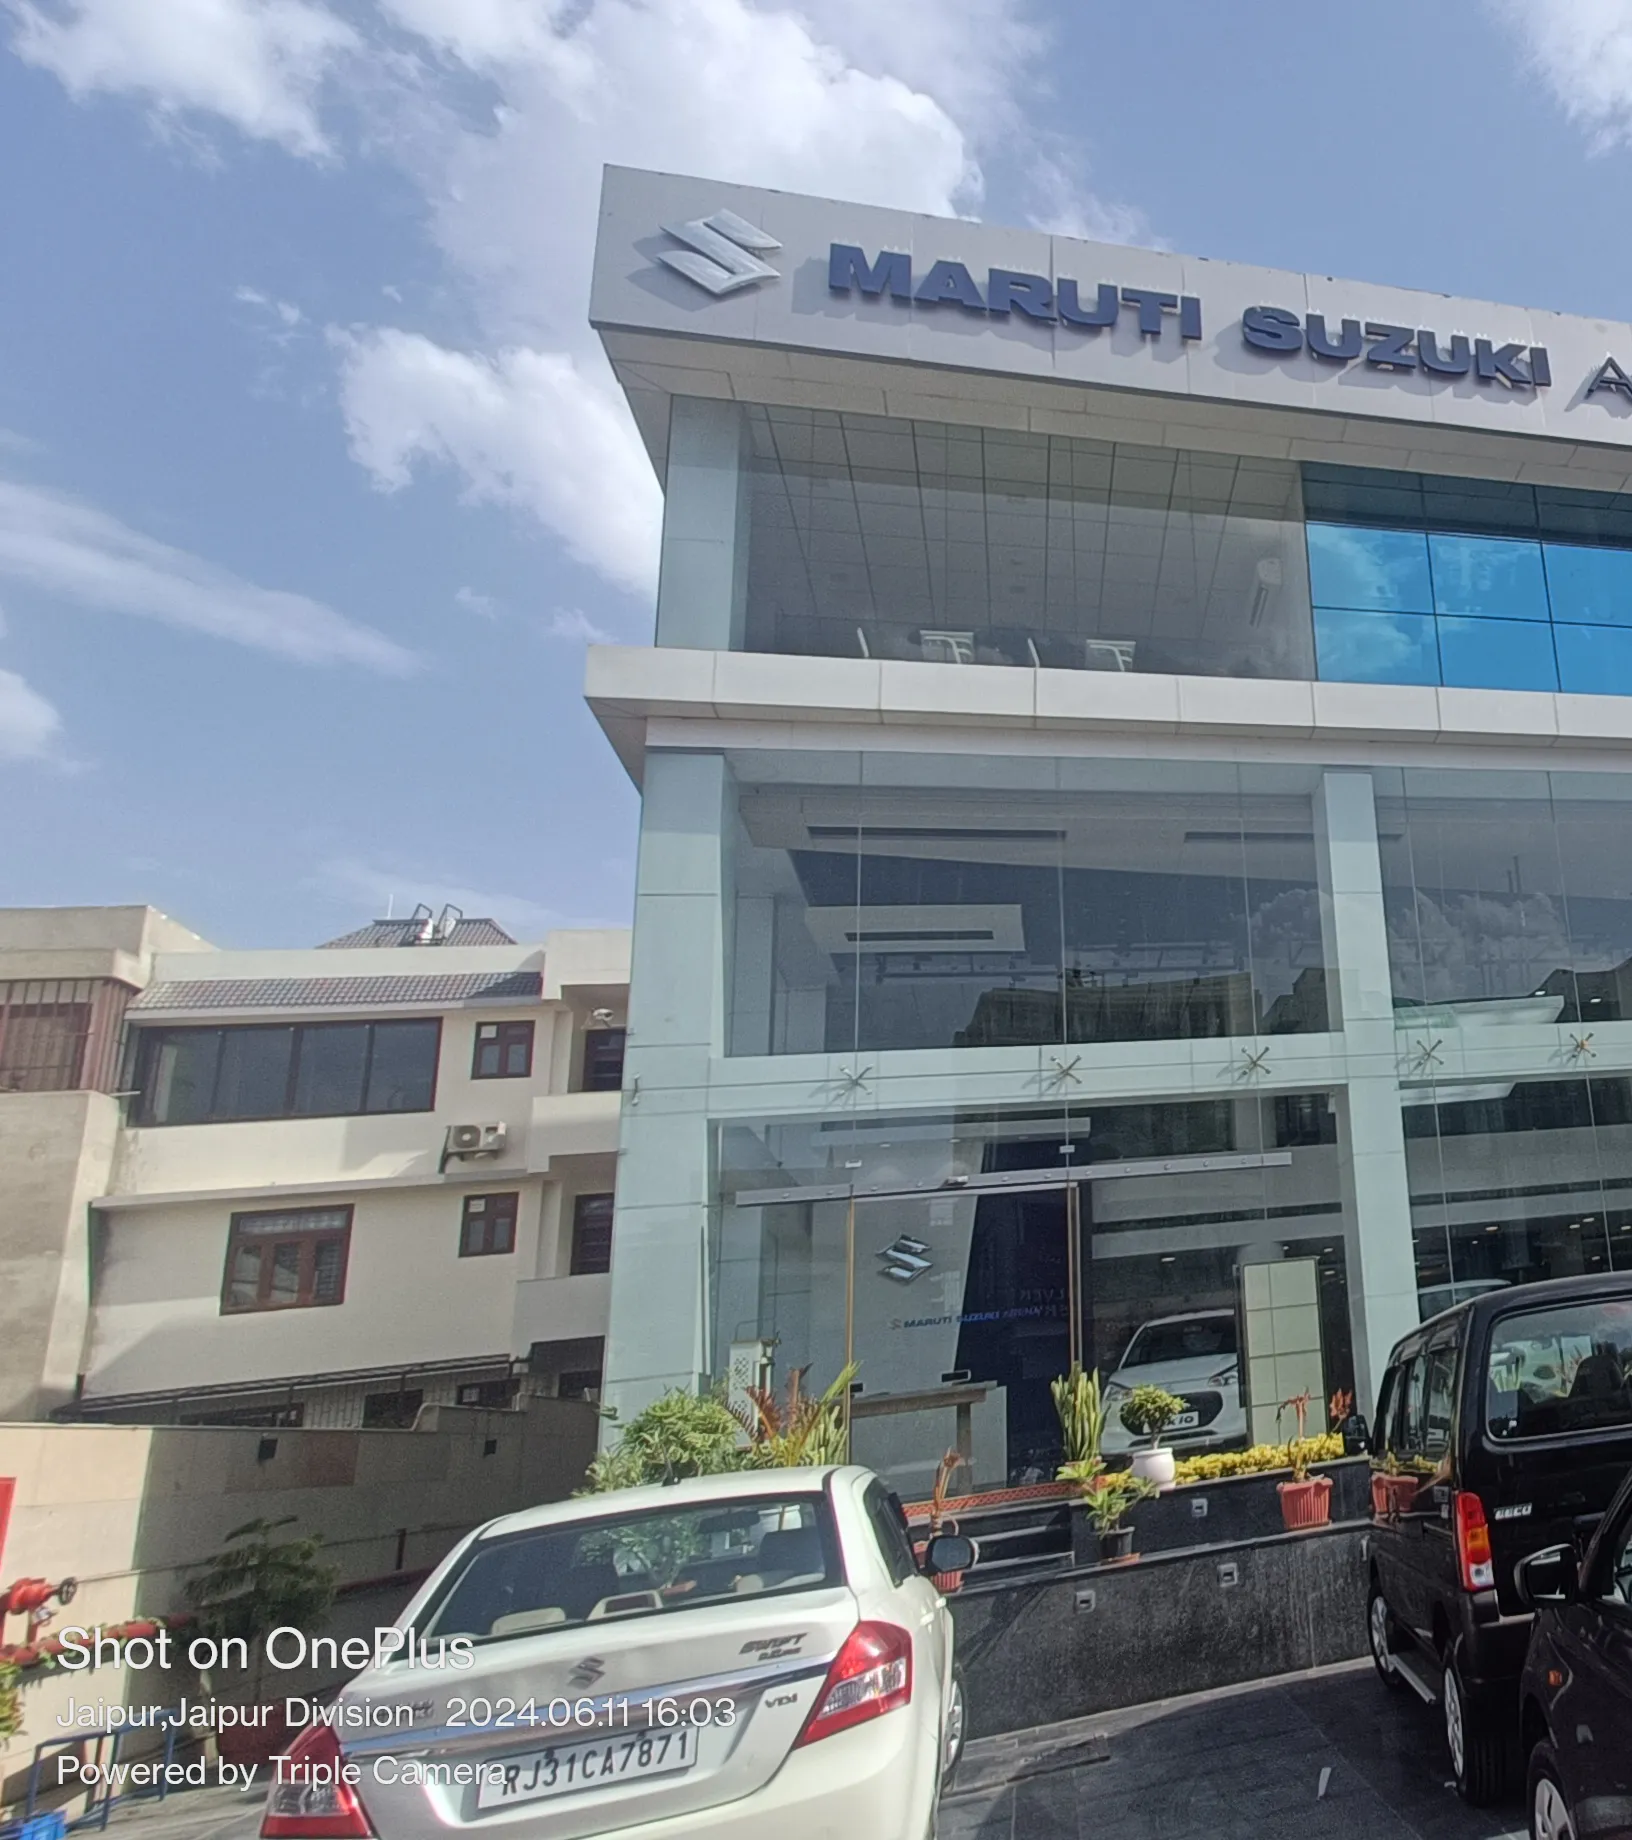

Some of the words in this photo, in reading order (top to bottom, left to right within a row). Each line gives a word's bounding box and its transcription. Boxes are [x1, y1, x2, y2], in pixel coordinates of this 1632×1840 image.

[828, 241, 1203, 341] MARUTI
[1241, 305, 1551, 388] SUZUKI
[903, 1315, 951, 1329] MARUTI
[501, 1731, 688, 1796] RJ31CA7871
